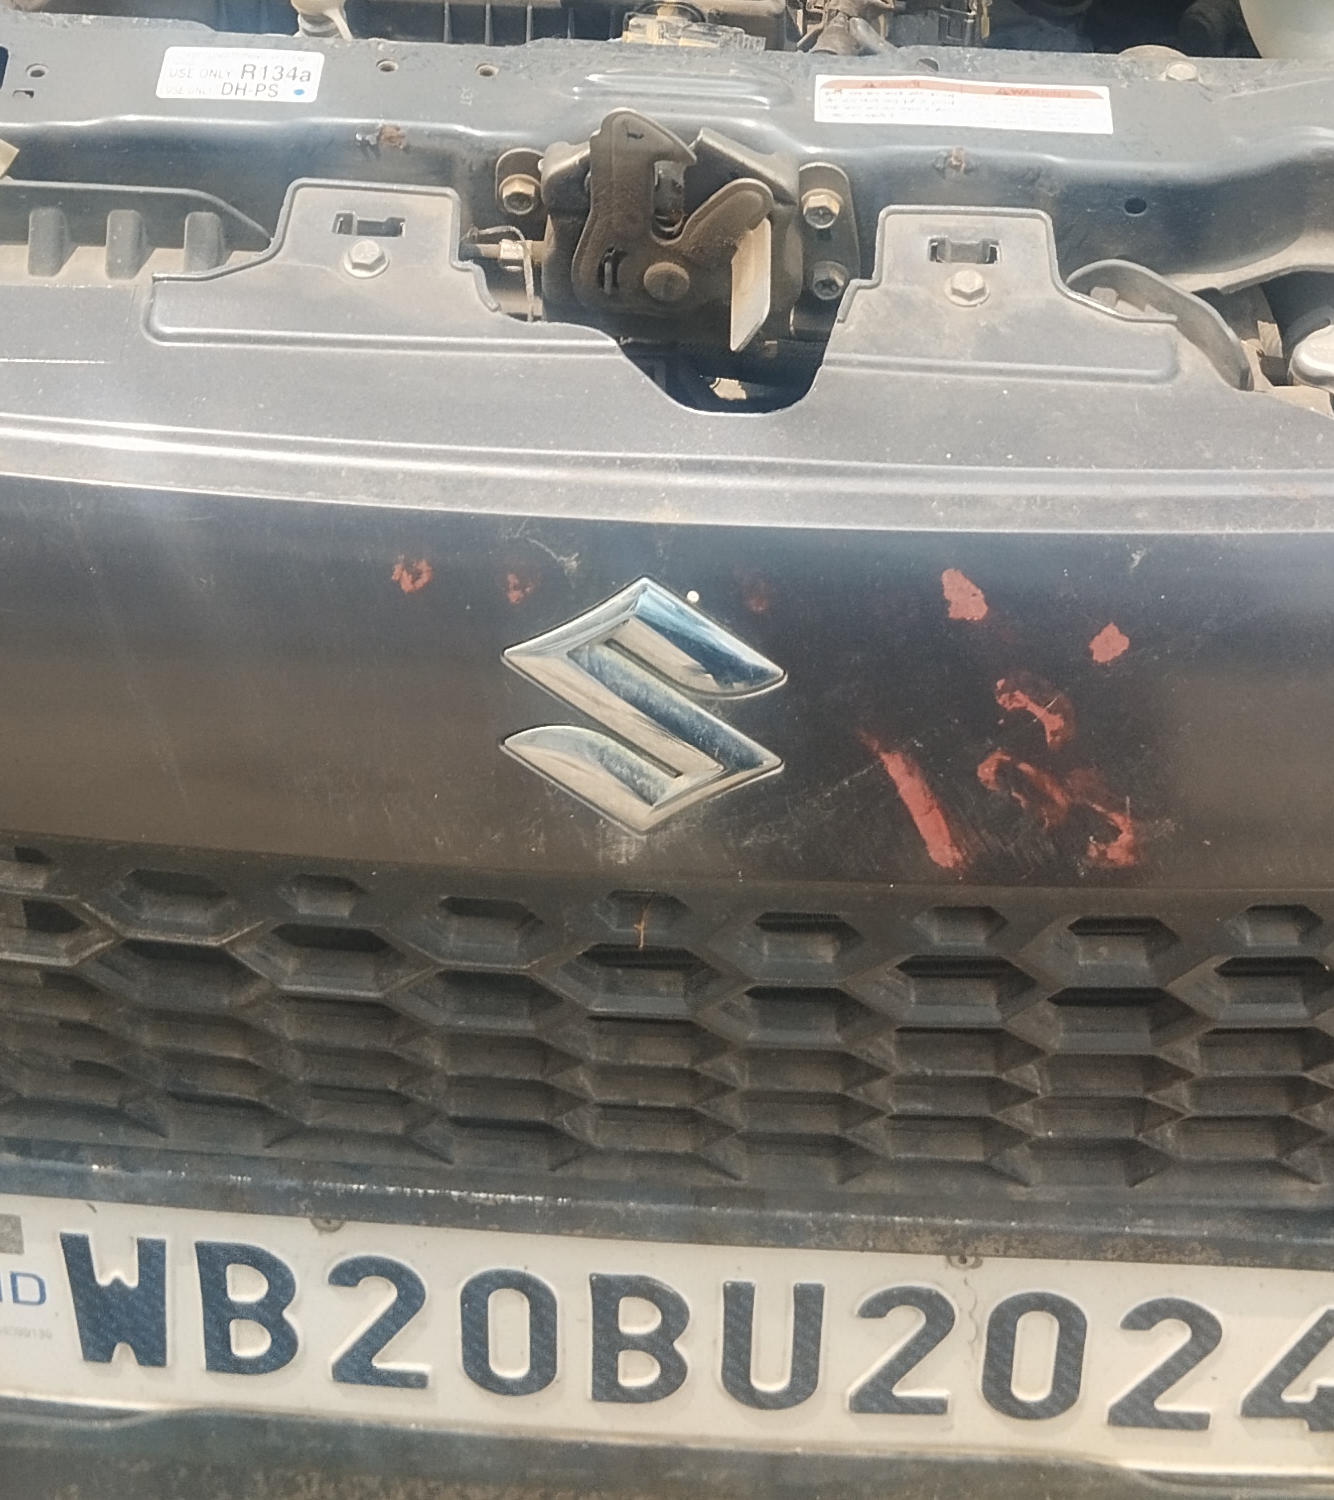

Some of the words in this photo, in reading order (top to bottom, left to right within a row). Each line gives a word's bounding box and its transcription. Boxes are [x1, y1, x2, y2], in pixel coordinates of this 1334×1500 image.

[170, 68, 193, 78] USE
[199, 68, 234, 79] ONLY
[240, 63, 312, 83] R134a
[220, 82, 279, 98] DH-PS
